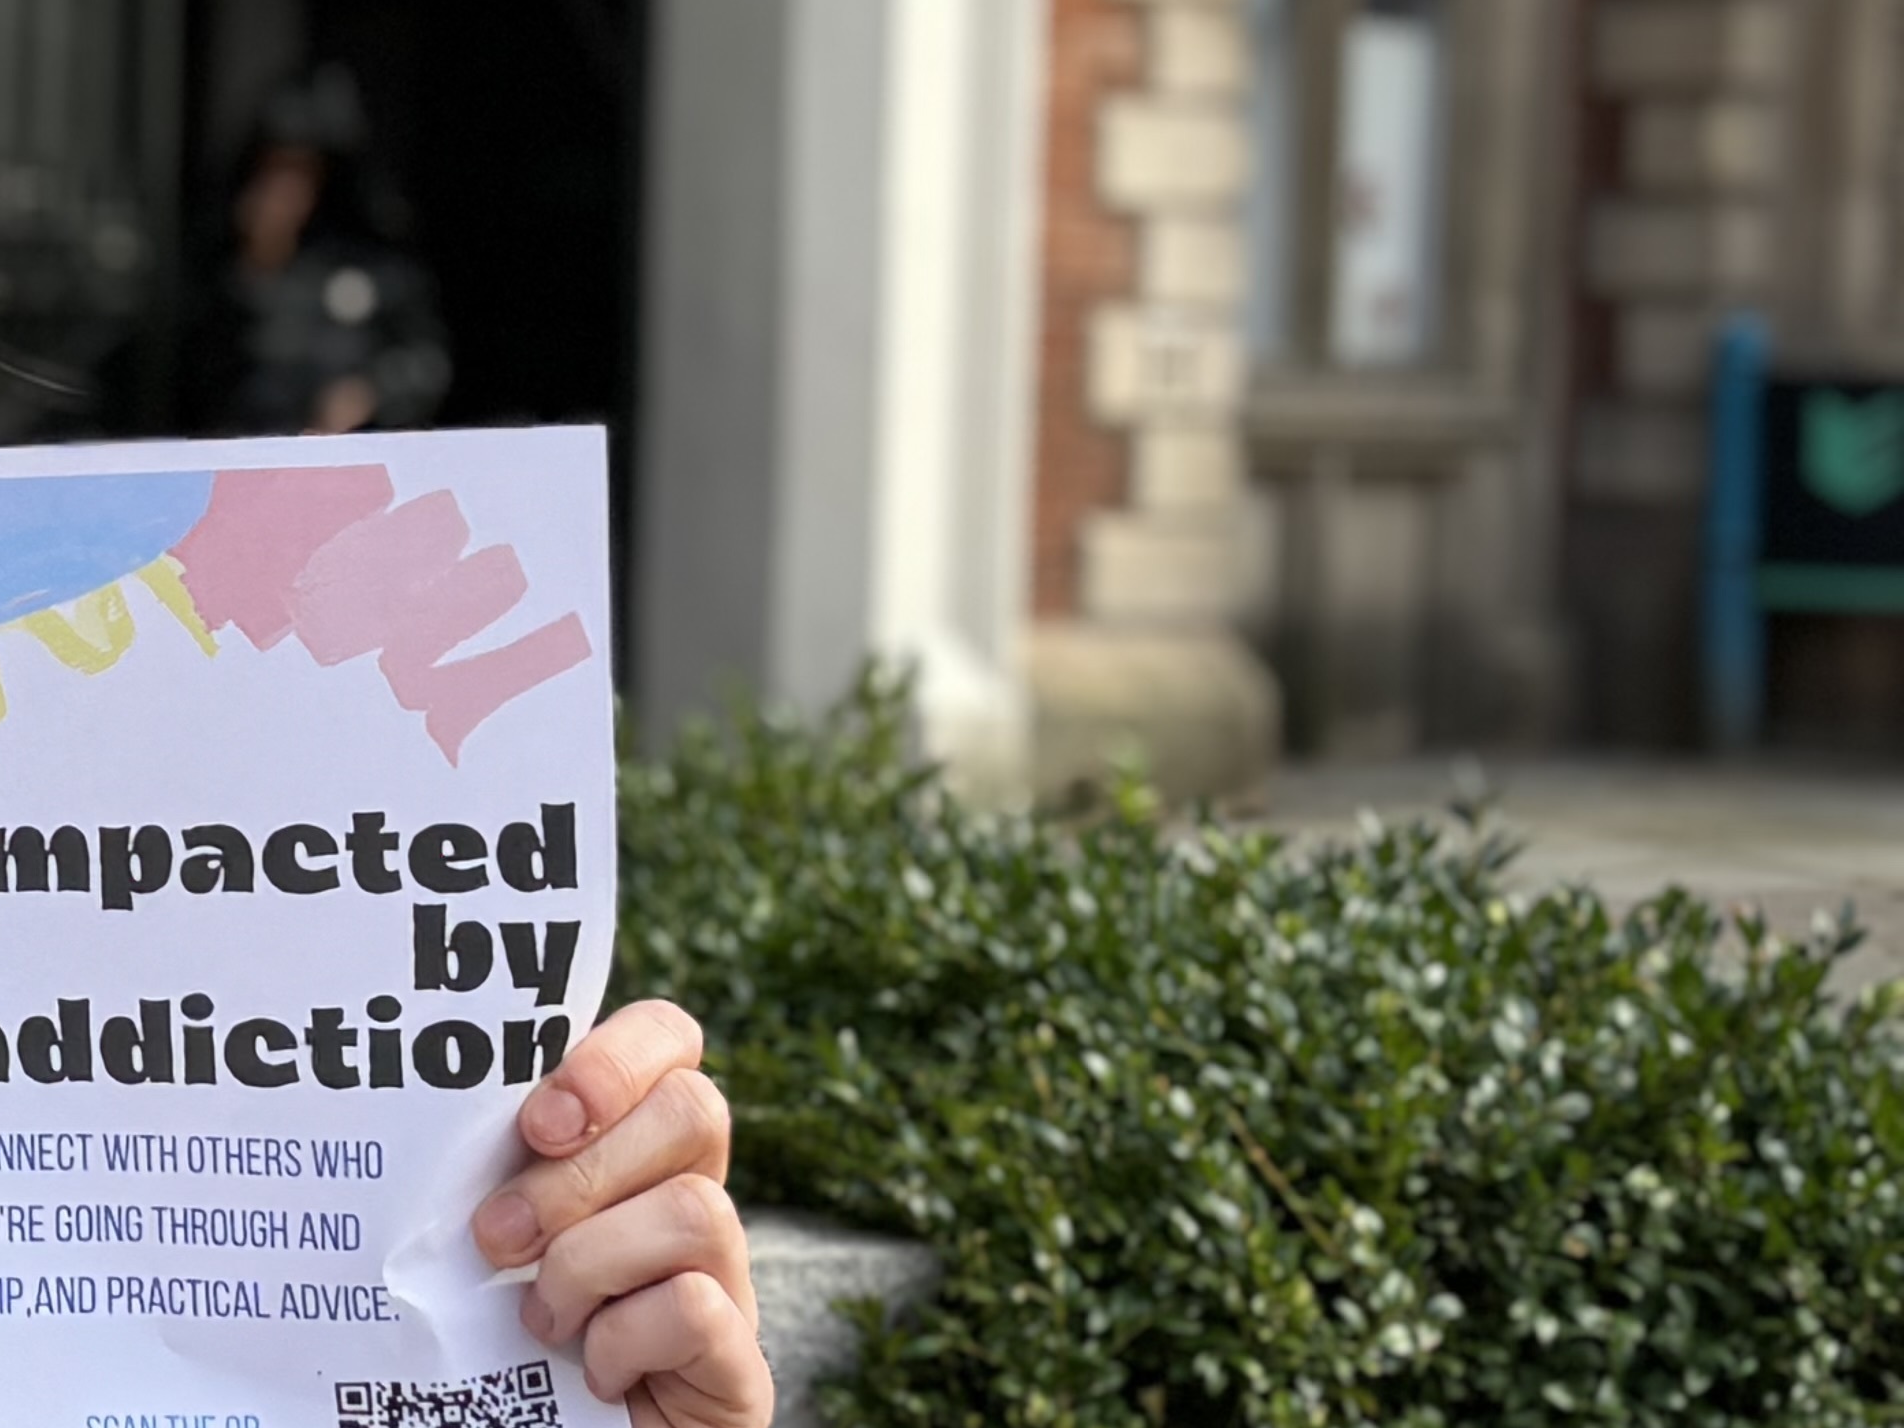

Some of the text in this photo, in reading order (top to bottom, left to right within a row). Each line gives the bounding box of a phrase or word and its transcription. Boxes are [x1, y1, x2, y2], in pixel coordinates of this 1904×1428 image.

[411, 902, 581, 1005] by
[102, 1133, 178, 1173] WITH
[187, 1135, 302, 1178] OTHERS
[310, 1139, 383, 1180] WHO
[55, 1204, 143, 1243] GOING
[150, 1206, 289, 1250] THROUGH
[298, 1211, 361, 1252] AND
[106, 1276, 271, 1319] PRACTICAL
[280, 1282, 401, 1322] ADVICE.
